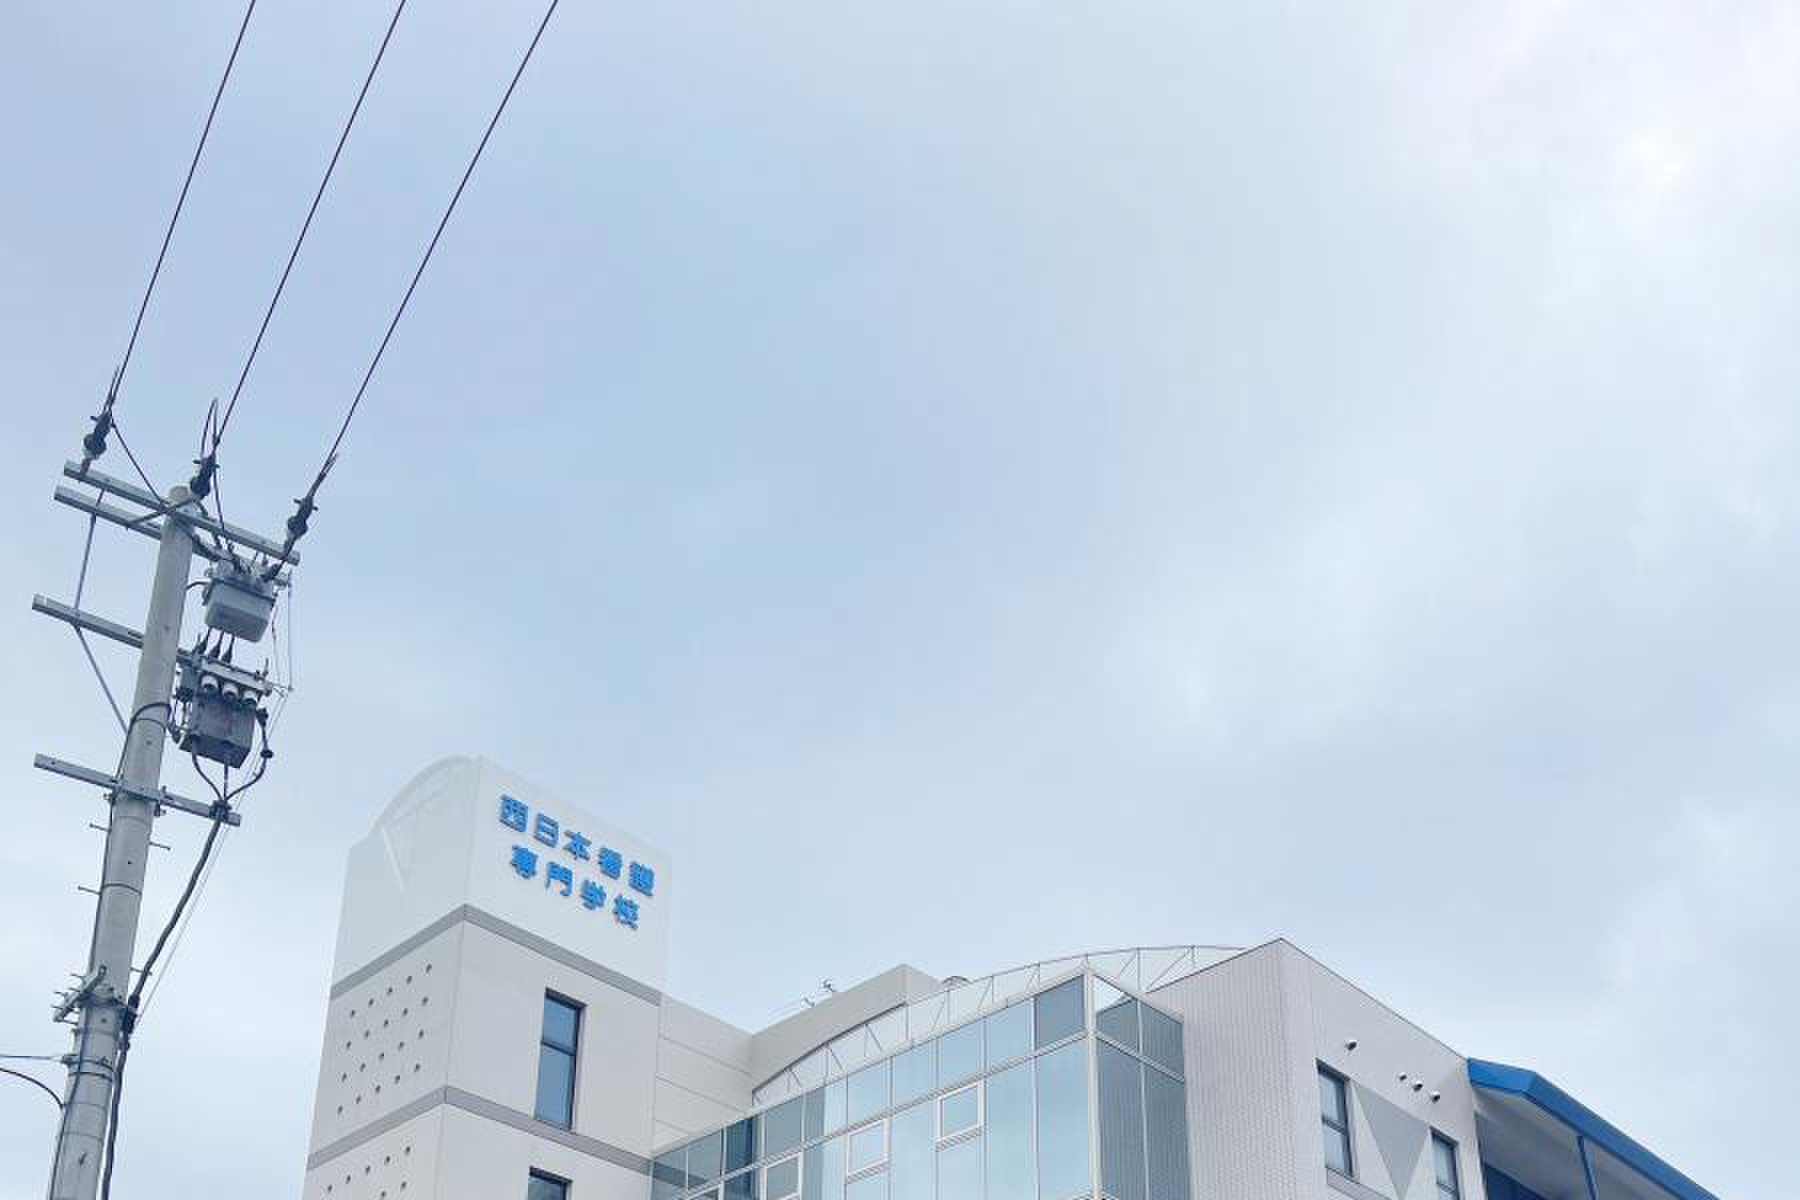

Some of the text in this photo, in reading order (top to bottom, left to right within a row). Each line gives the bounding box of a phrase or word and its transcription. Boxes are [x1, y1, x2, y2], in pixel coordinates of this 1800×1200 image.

[498, 794, 656, 897] 西日本看護
[510, 844, 640, 930] 専門学校
